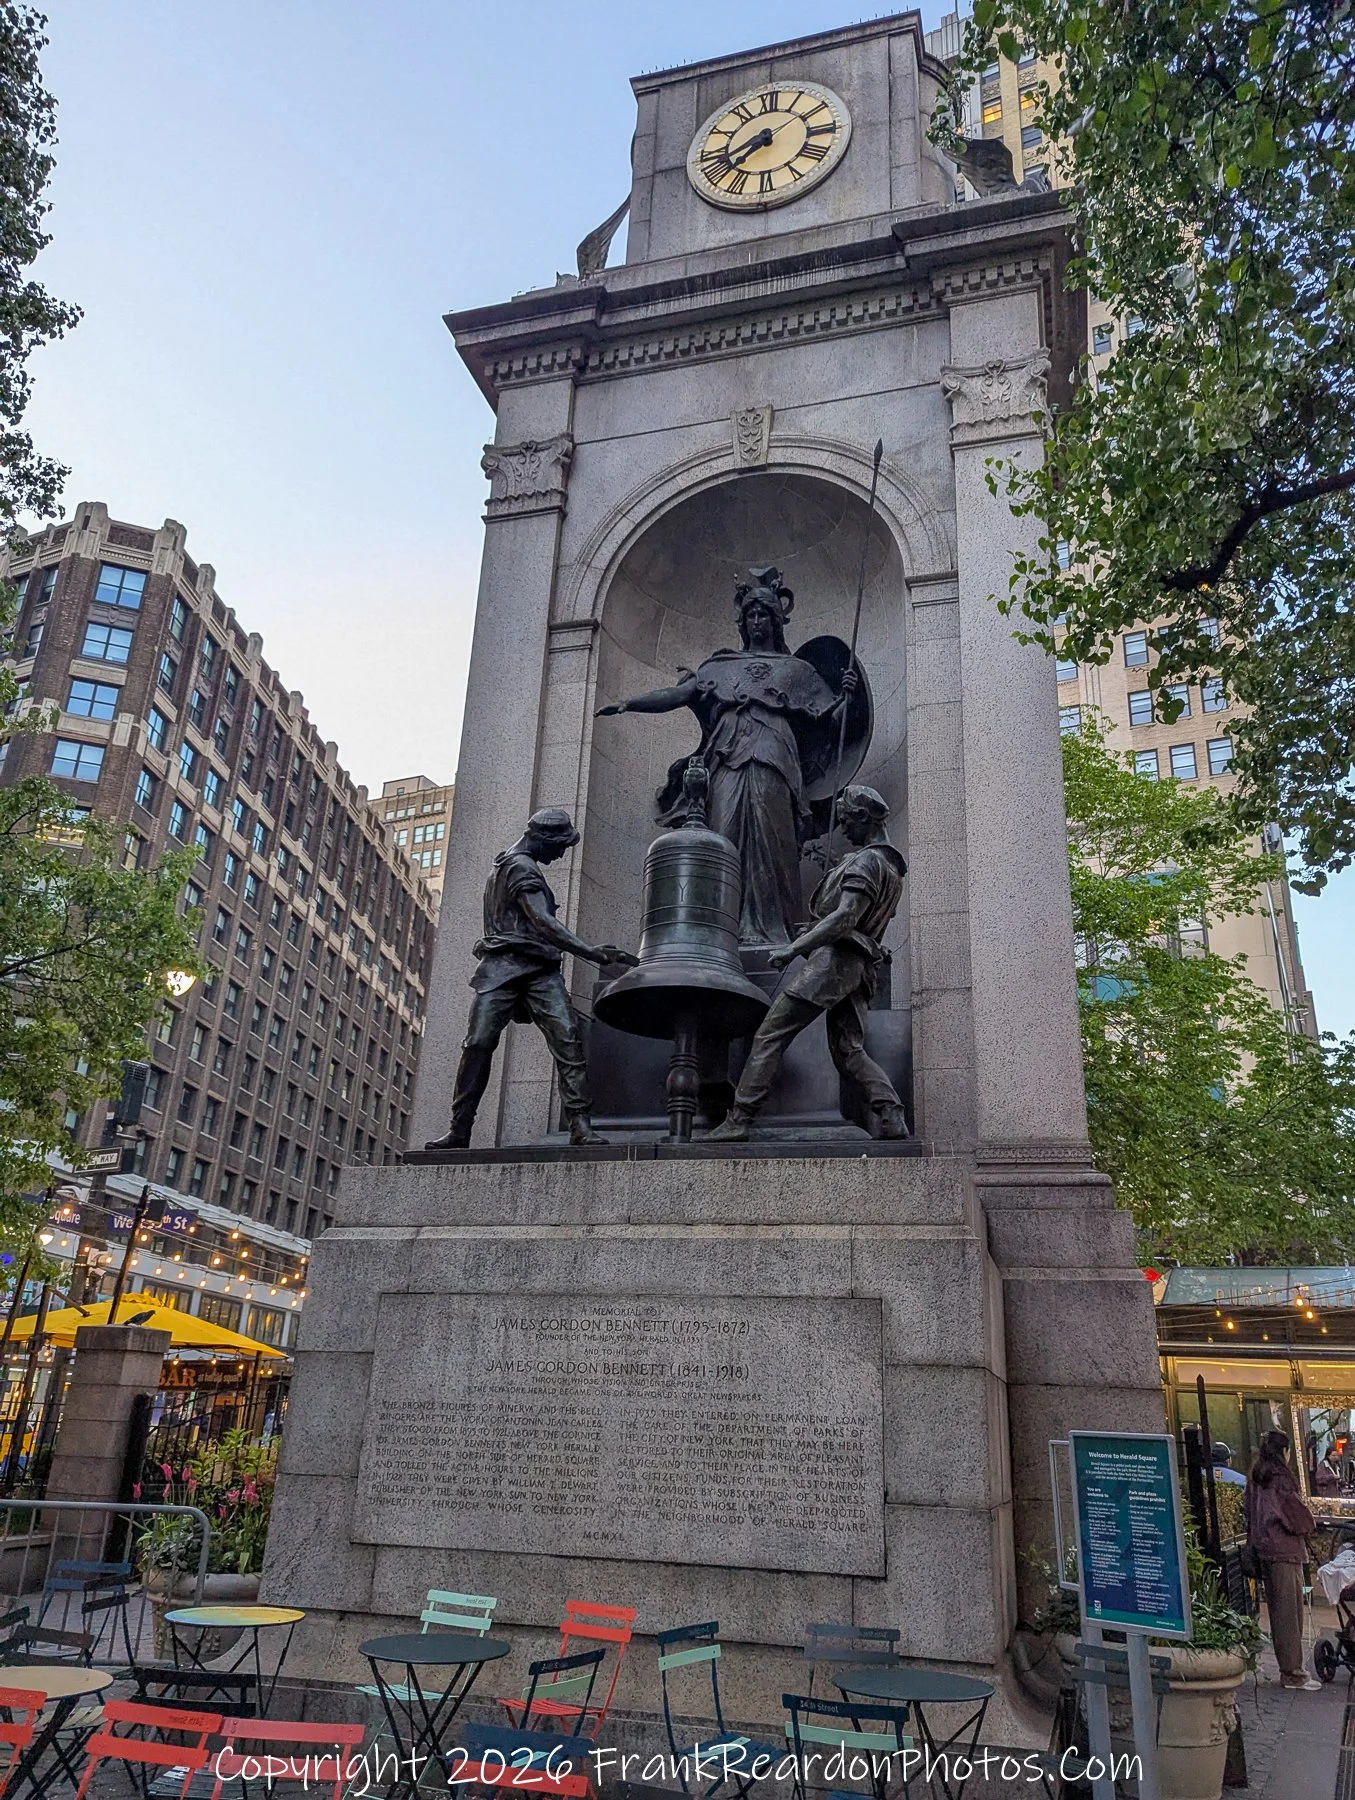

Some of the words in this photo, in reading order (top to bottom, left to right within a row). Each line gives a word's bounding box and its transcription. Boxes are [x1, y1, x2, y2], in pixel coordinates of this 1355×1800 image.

[757, 91, 781, 113] XII
[801, 102, 829, 121] II
[729, 102, 755, 125] XI
[709, 125, 735, 139] X
[807, 120, 837, 138] III
[801, 144, 831, 163] IIII
[784, 161, 805, 182] V
[724, 170, 751, 195] VII
[758, 170, 777, 193] VI
[99, 1154, 115, 1163] WAY
[173, 1216, 188, 1230] St
[490, 1317, 536, 1330] JAMES
[605, 1319, 670, 1333] BENNETT
[671, 1318, 750, 1335] (1795-1872)
[485, 1359, 532, 1372] JAMES
[602, 1361, 668, 1376] BENNETT
[669, 1362, 749, 1379] (1841-1918)
[1088, 1451, 1113, 1459] Welcome
[1138, 1454, 1158, 1462] Square
